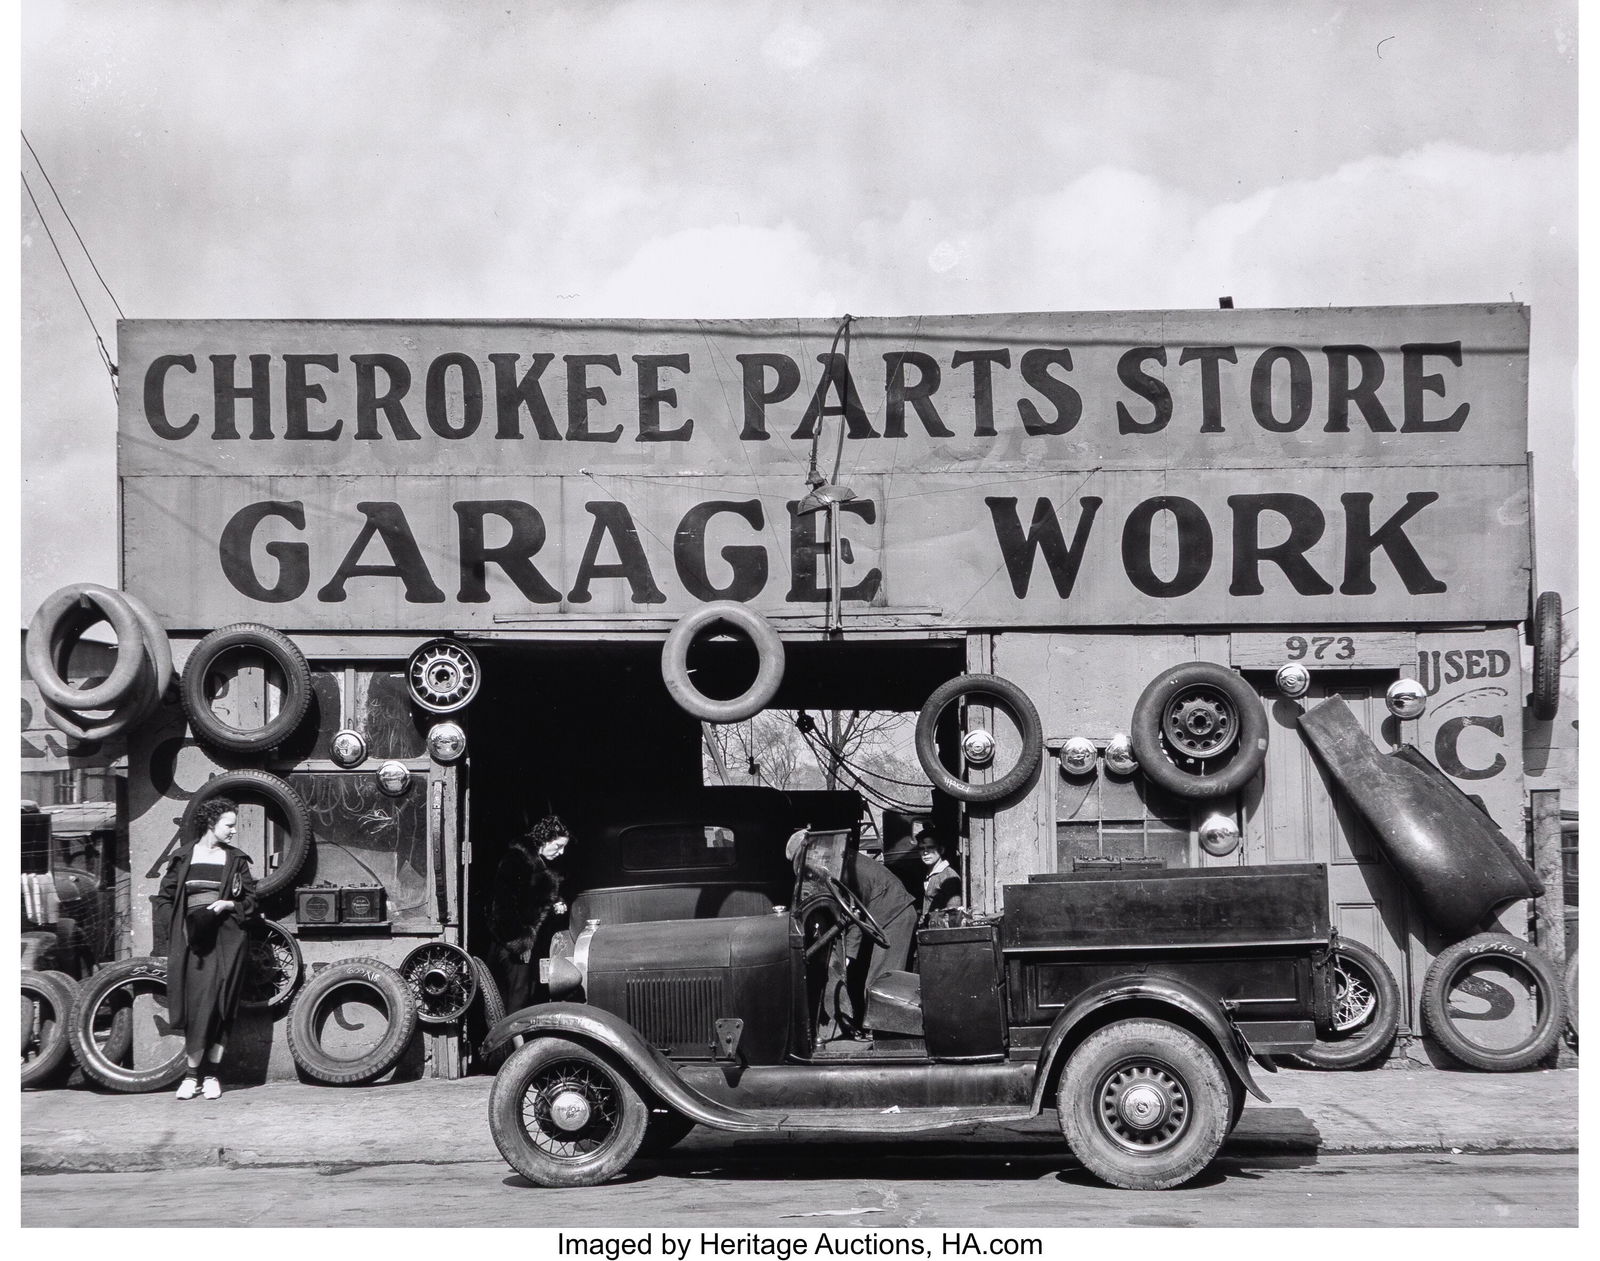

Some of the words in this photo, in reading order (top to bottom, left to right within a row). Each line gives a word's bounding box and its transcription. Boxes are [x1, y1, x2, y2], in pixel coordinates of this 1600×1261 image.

[144, 353, 694, 442] CHEROKEE
[736, 348, 1083, 441] PARTS
[1117, 341, 1470, 435] STORE
[219, 499, 882, 604] GARAGE
[985, 492, 1447, 599] WORK
[1285, 635, 1356, 661] 973
[1418, 649, 1511, 697] USED
